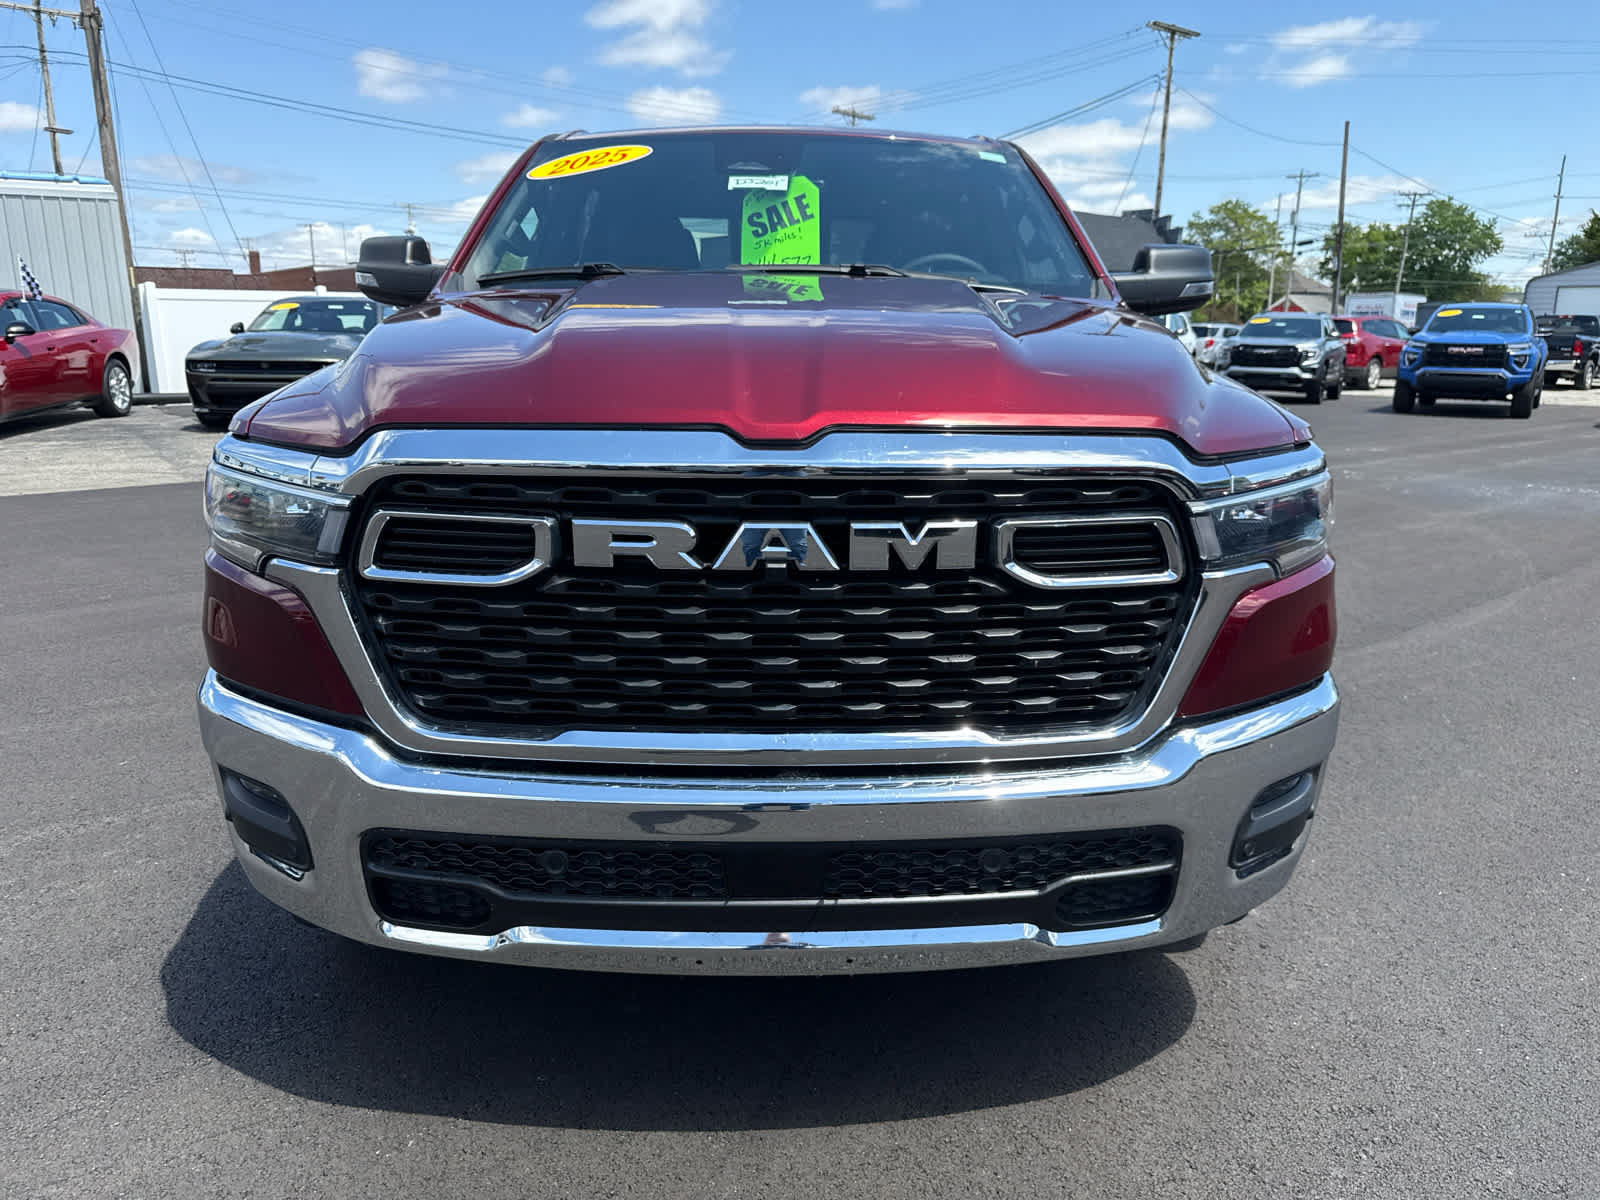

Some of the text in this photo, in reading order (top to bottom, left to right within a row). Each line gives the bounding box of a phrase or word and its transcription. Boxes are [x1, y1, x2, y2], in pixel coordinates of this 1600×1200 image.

[547, 147, 633, 175] 2025
[747, 192, 815, 238] SALE
[571, 518, 978, 571] RAM
